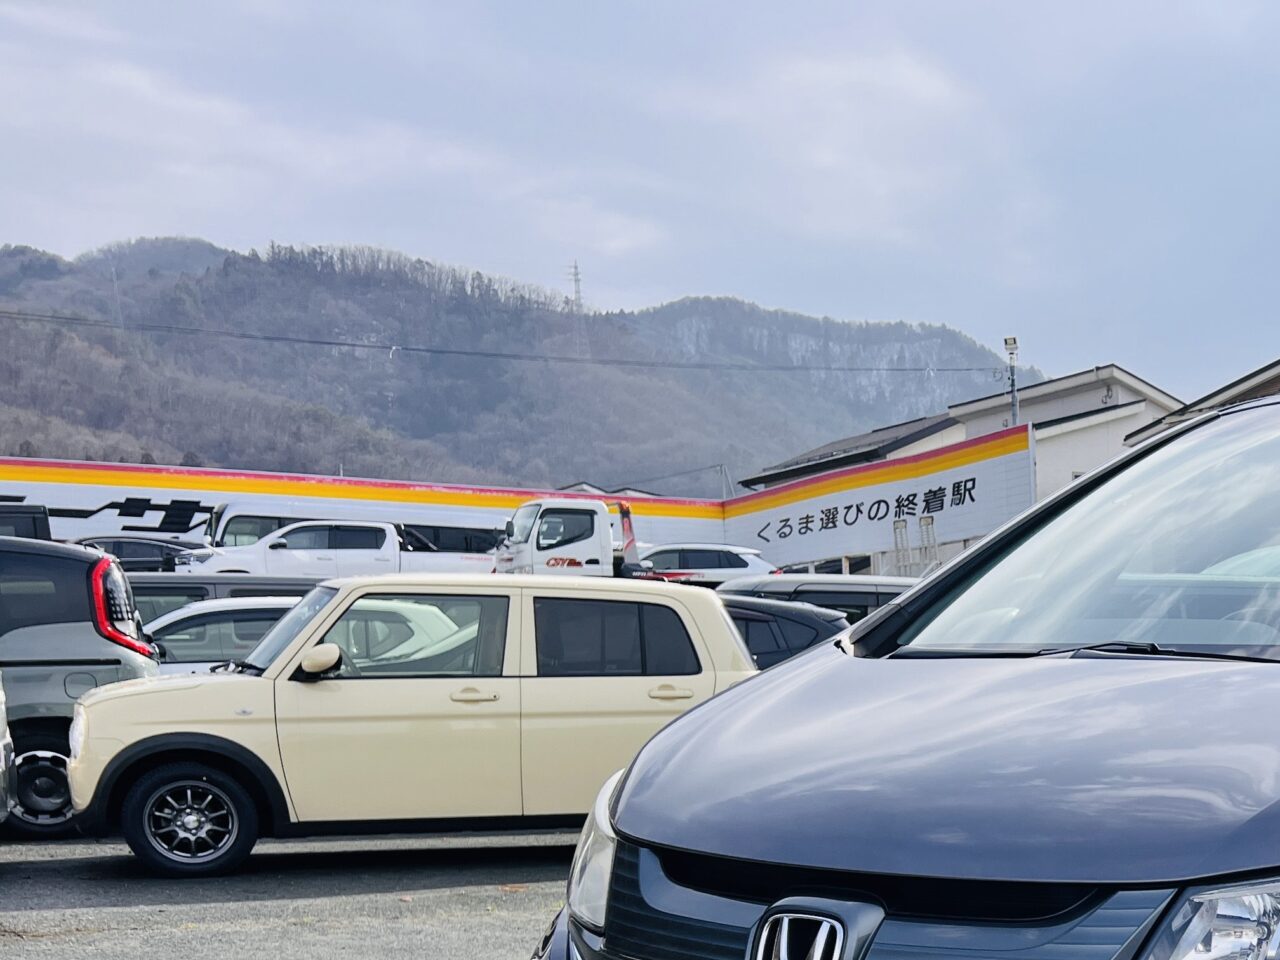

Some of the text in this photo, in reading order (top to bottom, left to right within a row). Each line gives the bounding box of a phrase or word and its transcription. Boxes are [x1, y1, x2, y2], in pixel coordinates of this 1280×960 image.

[756, 477, 977, 543] くるま選びの終着駅
